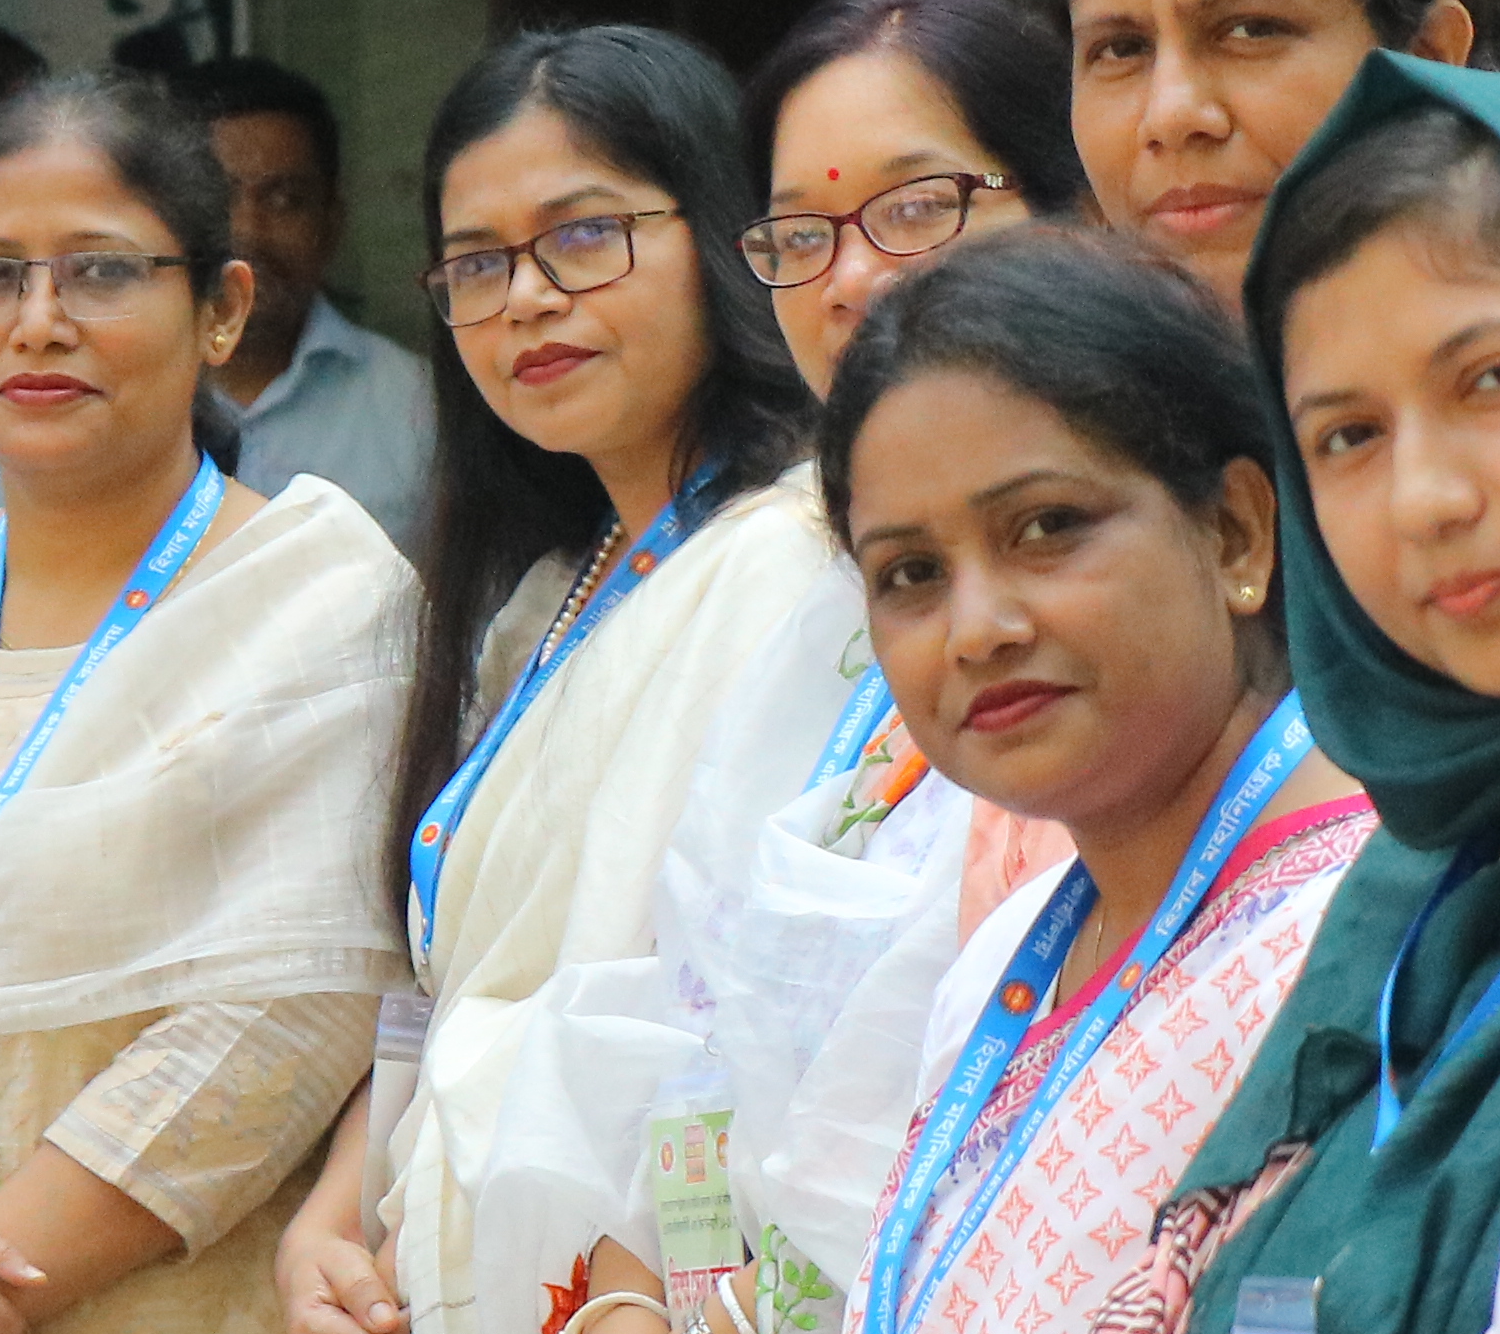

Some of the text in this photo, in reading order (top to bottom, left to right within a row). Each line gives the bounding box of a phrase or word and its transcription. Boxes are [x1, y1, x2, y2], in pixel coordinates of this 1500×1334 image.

[149, 531, 189, 575] হিসাব
[1153, 869, 1206, 936] হিসাব
[958, 1035, 1007, 1097] হিসাব
[1044, 1017, 1105, 1102] কার্যালয়
